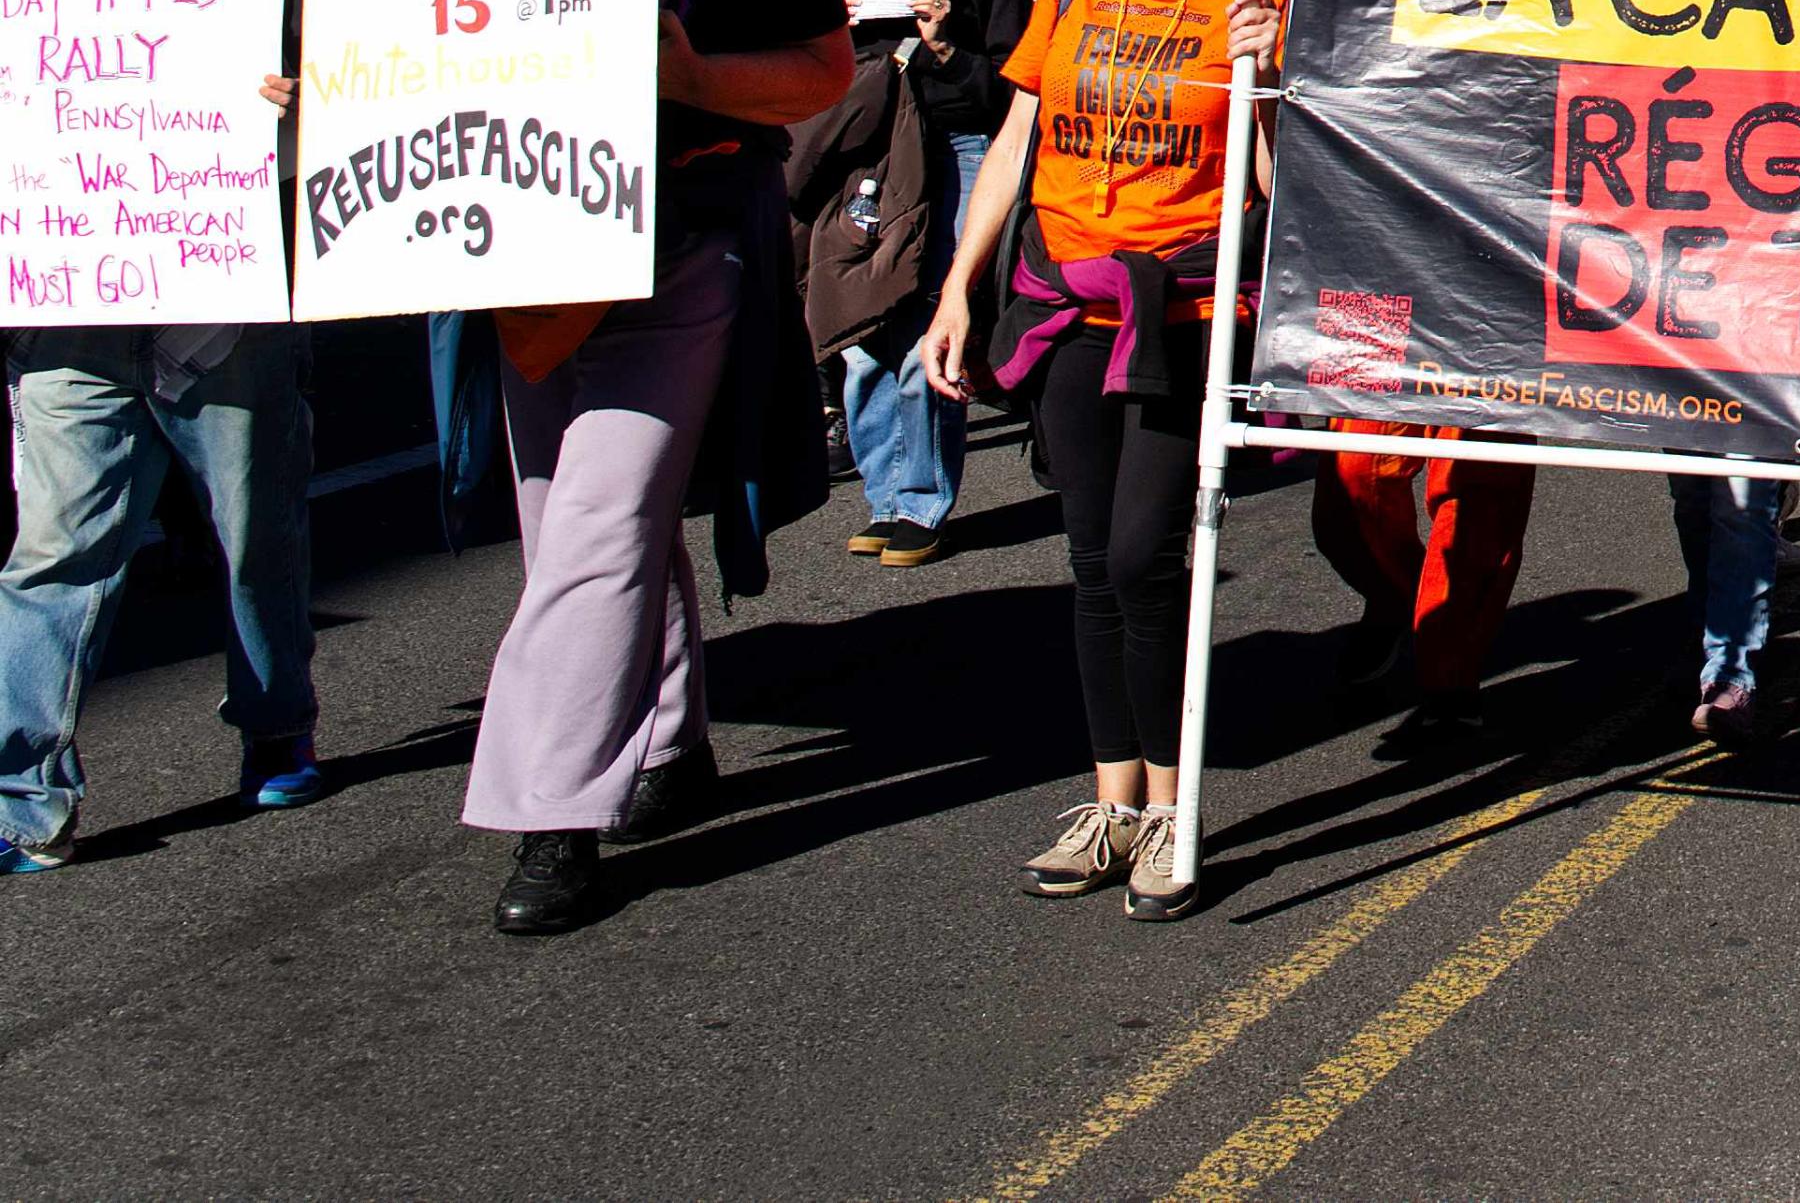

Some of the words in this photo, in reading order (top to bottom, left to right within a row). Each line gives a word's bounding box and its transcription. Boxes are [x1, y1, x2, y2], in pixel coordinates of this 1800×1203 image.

[37, 30, 170, 84] RALLY
[1073, 23, 1203, 73] TRUMP
[1075, 67, 1181, 121] MUST
[1053, 112, 1094, 159] GO
[1101, 120, 1203, 170] NOW!
[305, 109, 644, 261] REFUSEFASCISM
[37, 203, 95, 237] the
[405, 202, 494, 258] .org
[95, 252, 161, 311] GO!
[1556, 221, 1729, 342] DE
